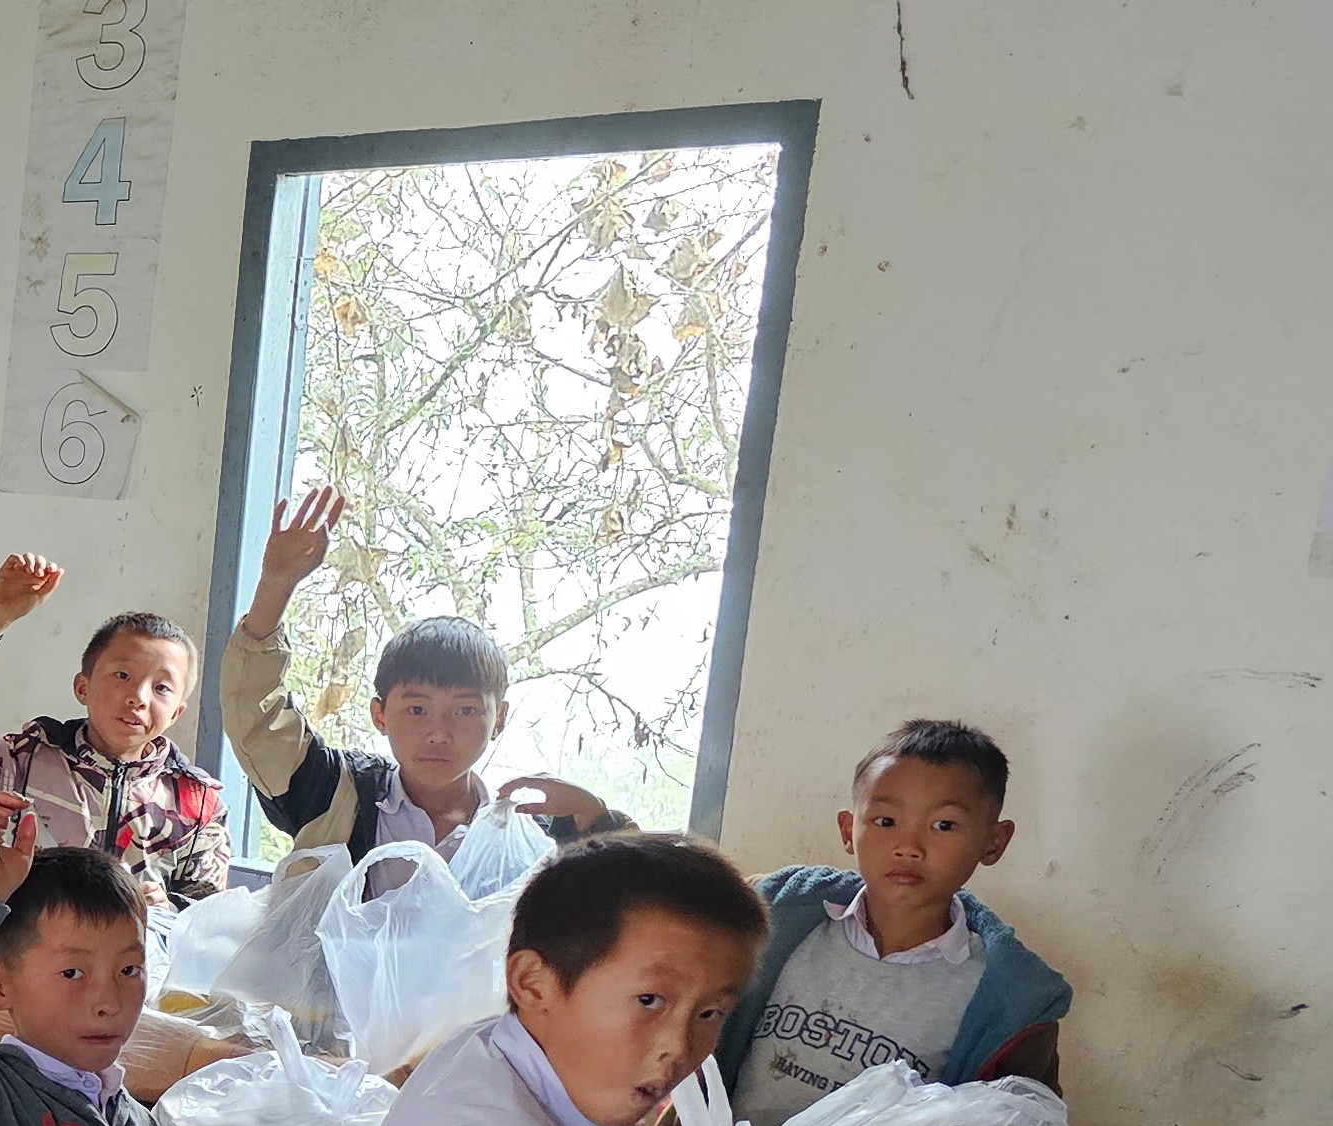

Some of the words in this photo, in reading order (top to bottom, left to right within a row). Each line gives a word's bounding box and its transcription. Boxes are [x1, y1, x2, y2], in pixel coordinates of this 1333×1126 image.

[76, 0, 147, 90] 3
[62, 117, 131, 225] 4
[50, 253, 119, 358] 5
[41, 382, 107, 485] 6
